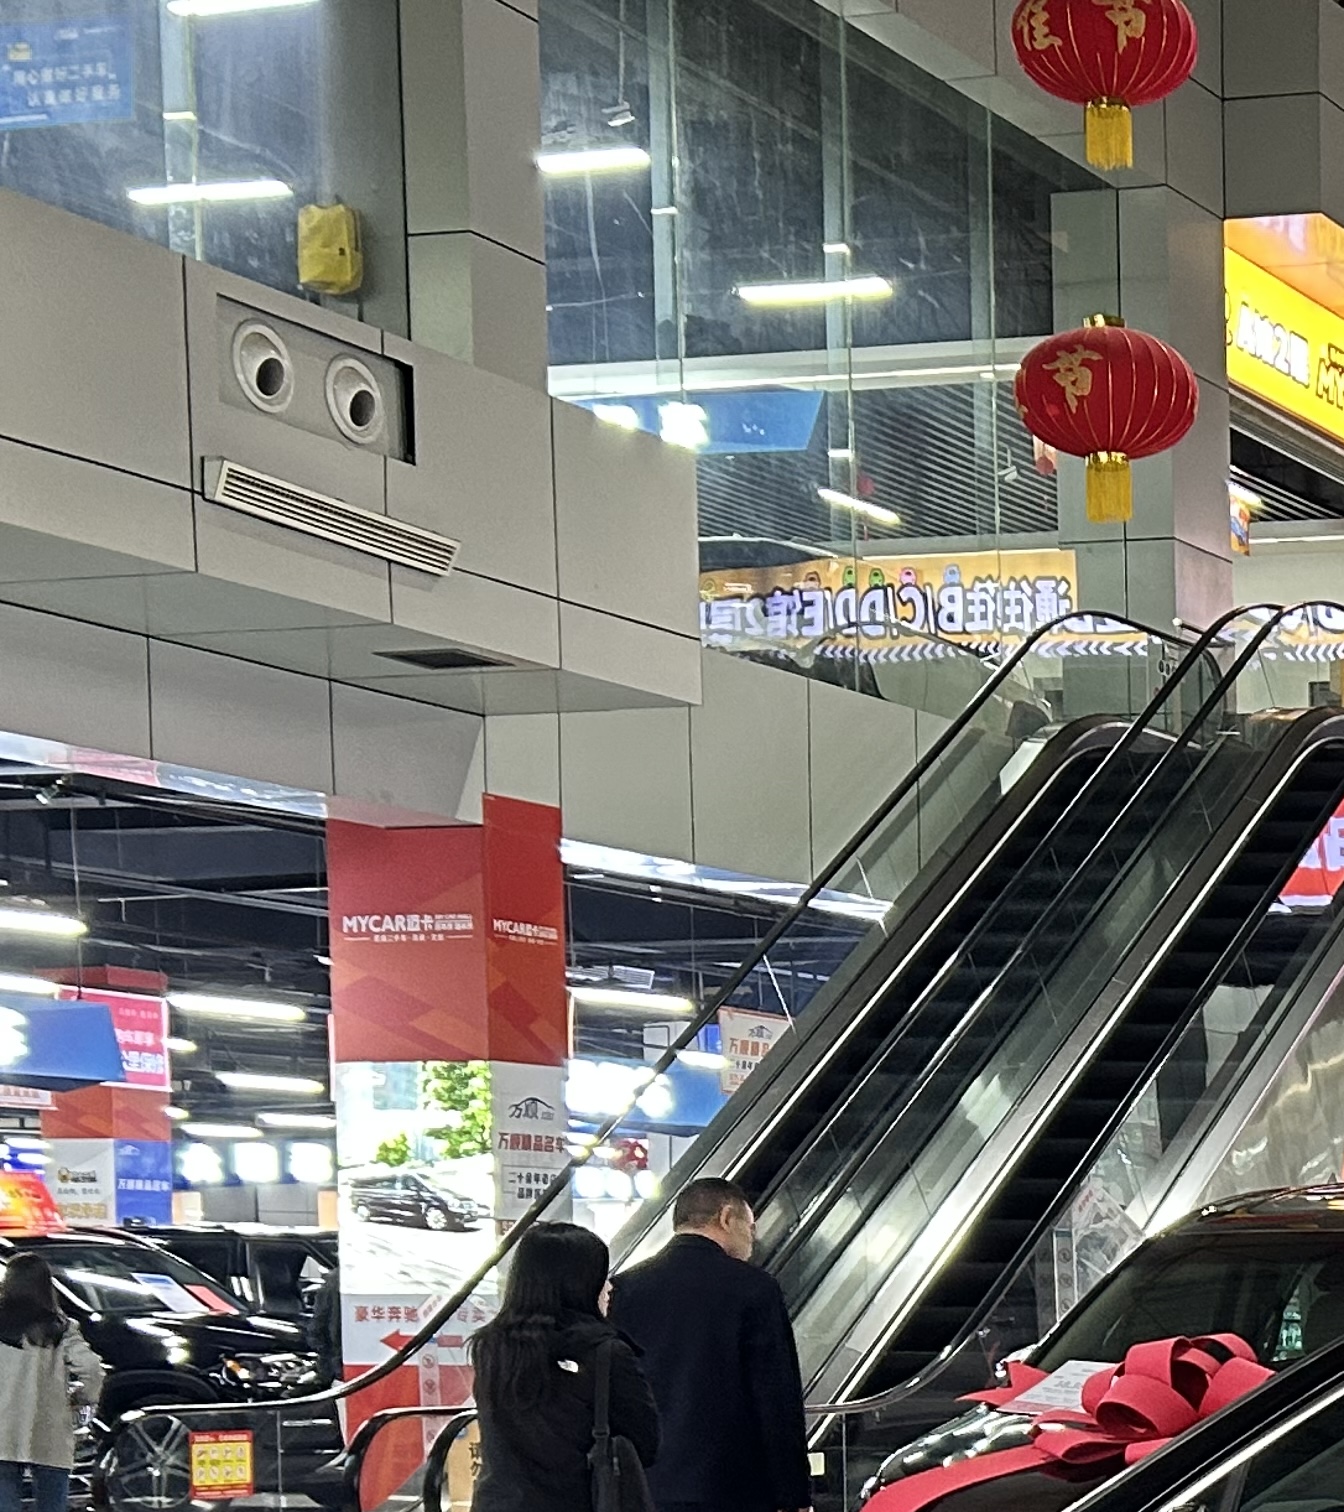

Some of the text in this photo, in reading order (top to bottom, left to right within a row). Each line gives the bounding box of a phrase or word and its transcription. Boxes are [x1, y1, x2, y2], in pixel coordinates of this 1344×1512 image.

[498, 1131, 566, 1154] 万顺精品名车
